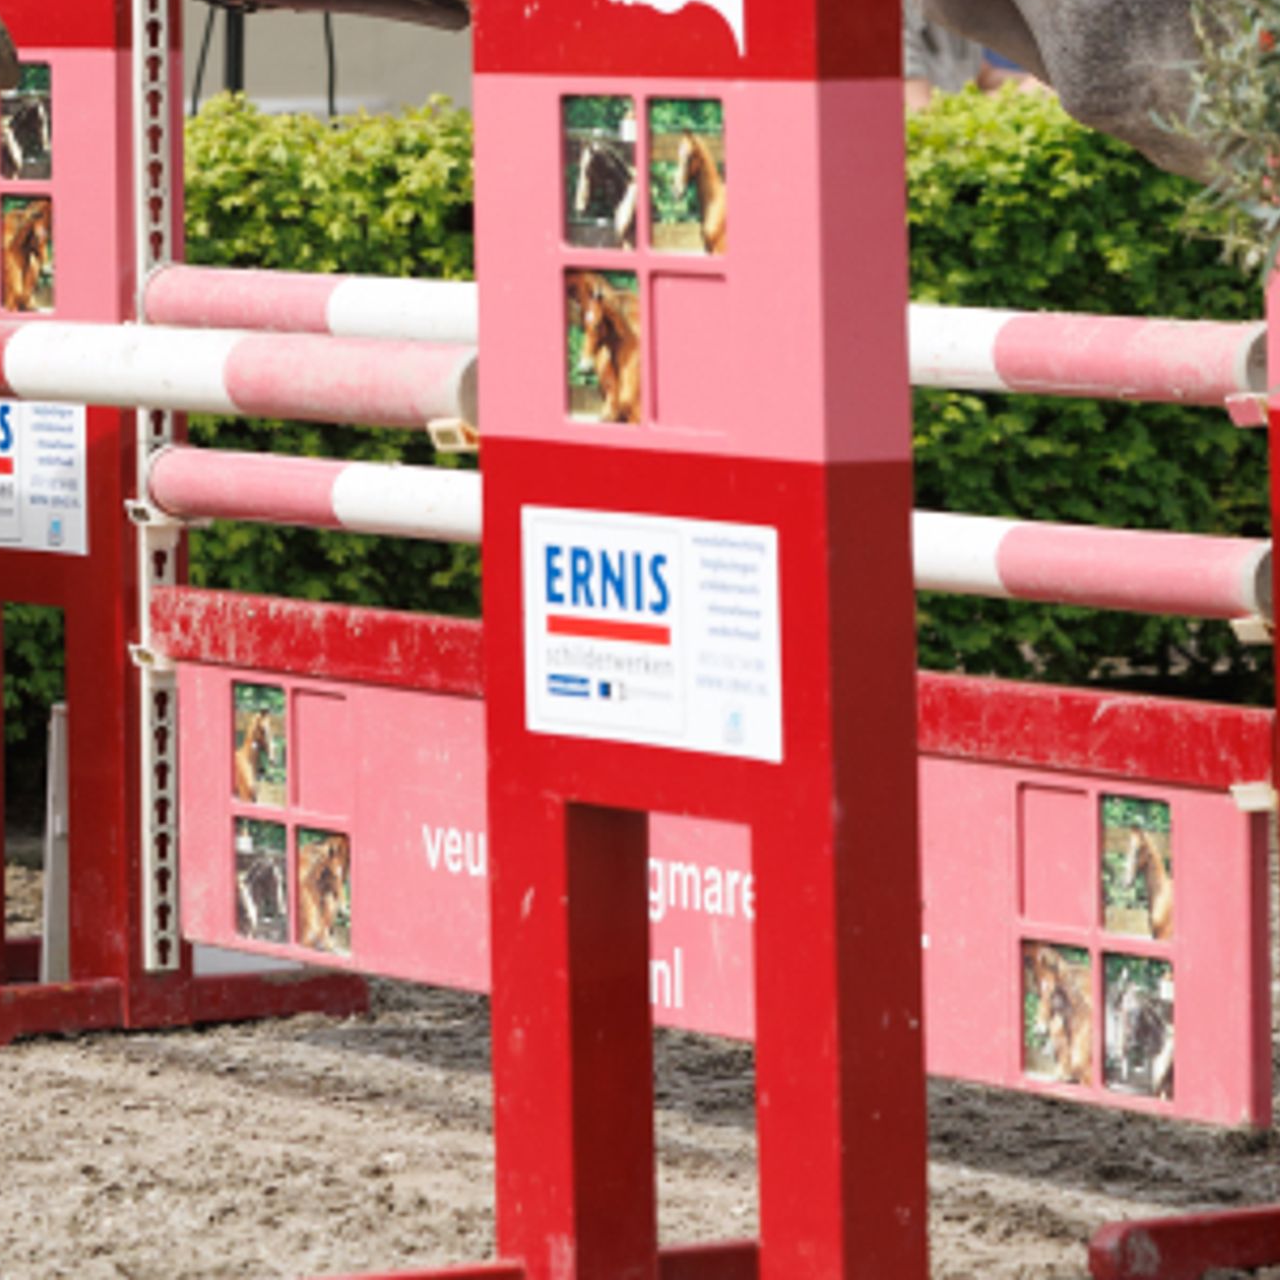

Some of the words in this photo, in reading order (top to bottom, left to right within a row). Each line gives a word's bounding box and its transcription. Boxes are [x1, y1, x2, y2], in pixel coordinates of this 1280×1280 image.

[544, 543, 671, 616] ERNIS
[422, 822, 487, 877] veu
[648, 856, 756, 922] gmare
[650, 946, 684, 1010] nl
